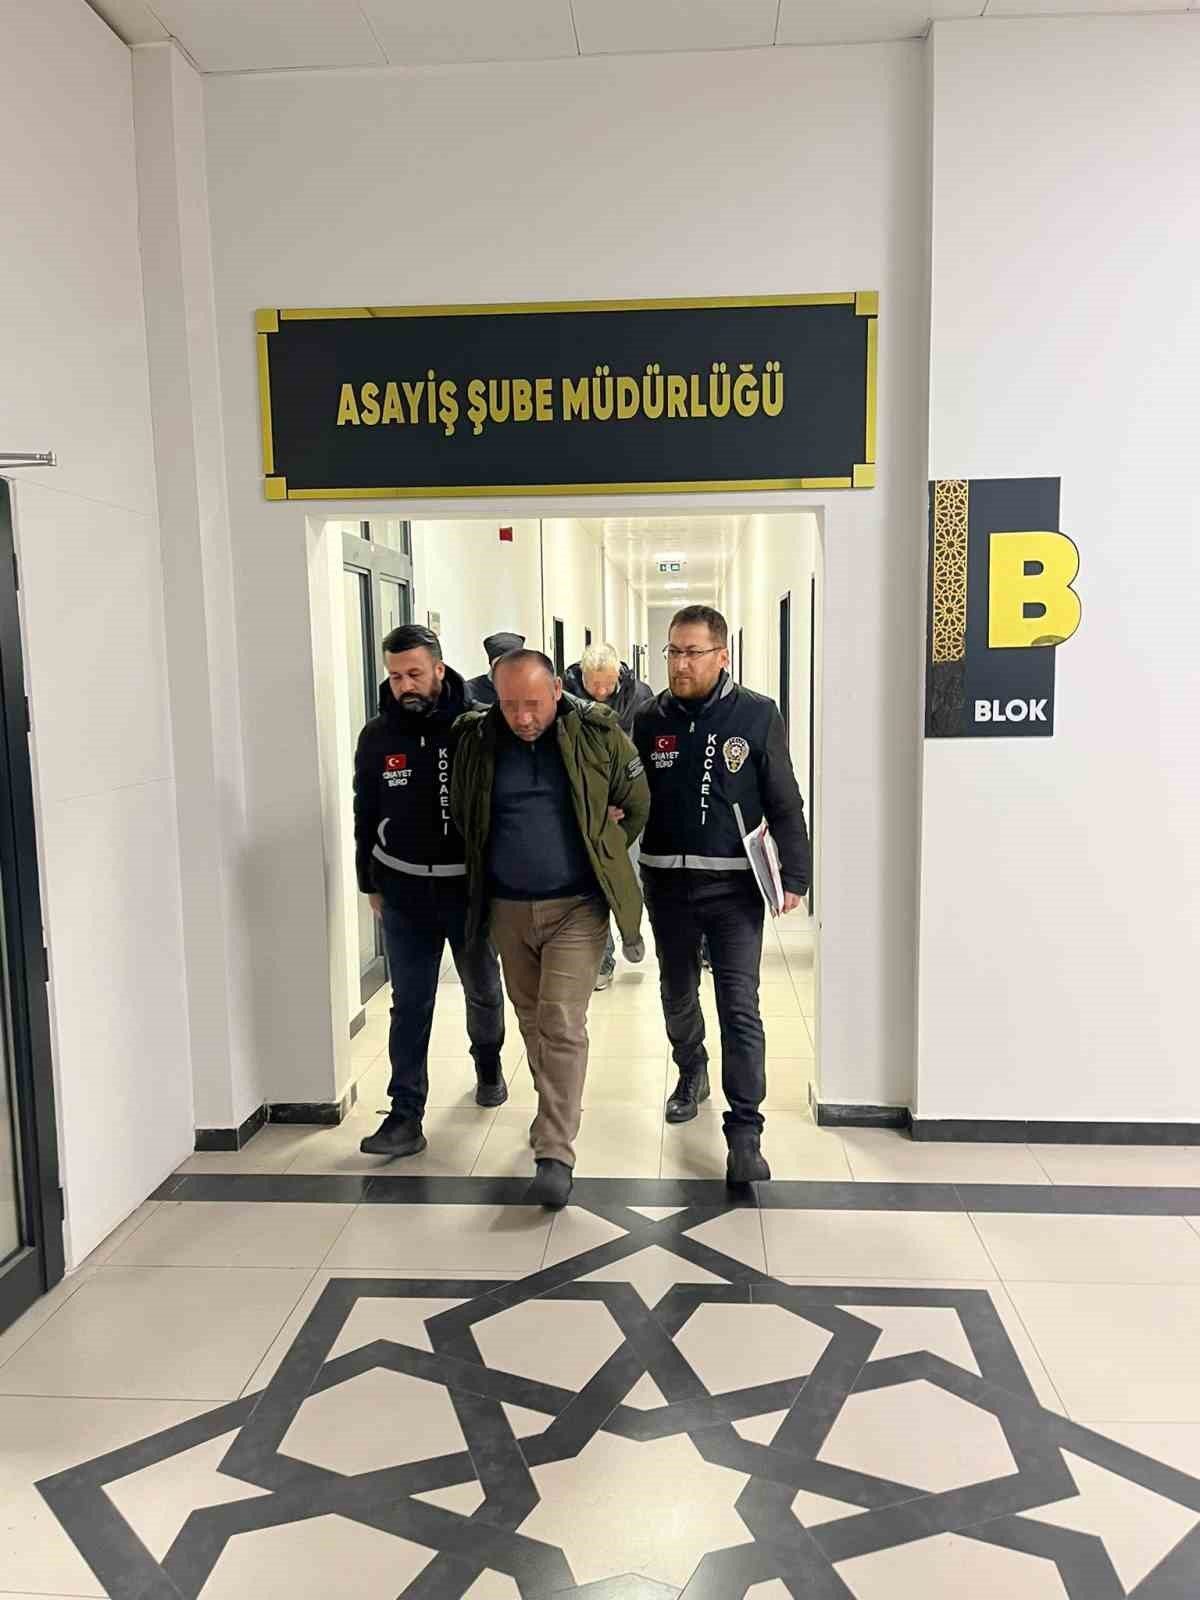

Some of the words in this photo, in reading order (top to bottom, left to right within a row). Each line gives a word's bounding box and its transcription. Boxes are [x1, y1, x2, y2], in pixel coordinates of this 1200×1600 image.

[336, 369, 459, 436] ASAYİŞ
[467, 377, 554, 436] ŞUBE
[562, 361, 784, 421] MÜDÜRLÜĞÜ
[988, 531, 1081, 648] B
[974, 699, 1048, 722] BLOK
